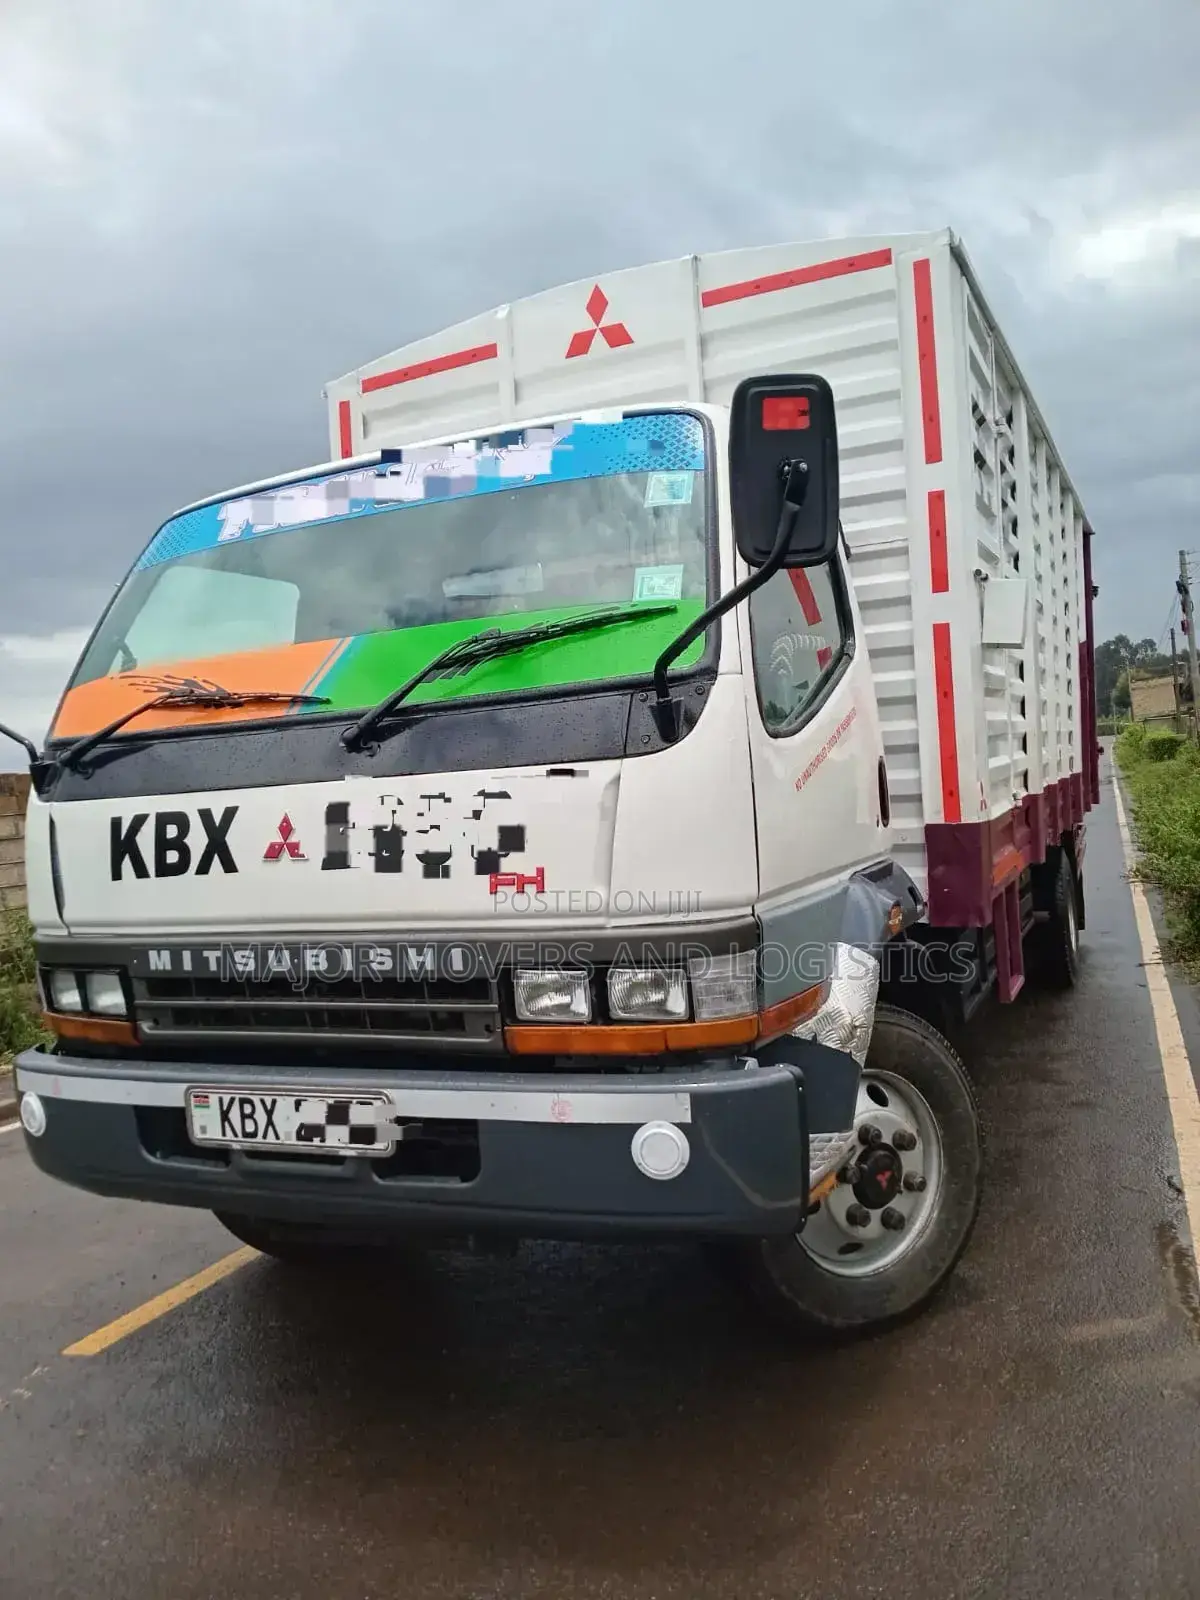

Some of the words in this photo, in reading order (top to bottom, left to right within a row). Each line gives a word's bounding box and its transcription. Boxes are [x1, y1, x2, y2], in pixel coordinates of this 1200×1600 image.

[110, 806, 240, 881] KBX
[148, 947, 465, 972] MITSUBISHI
[218, 1096, 281, 1140] KBX
